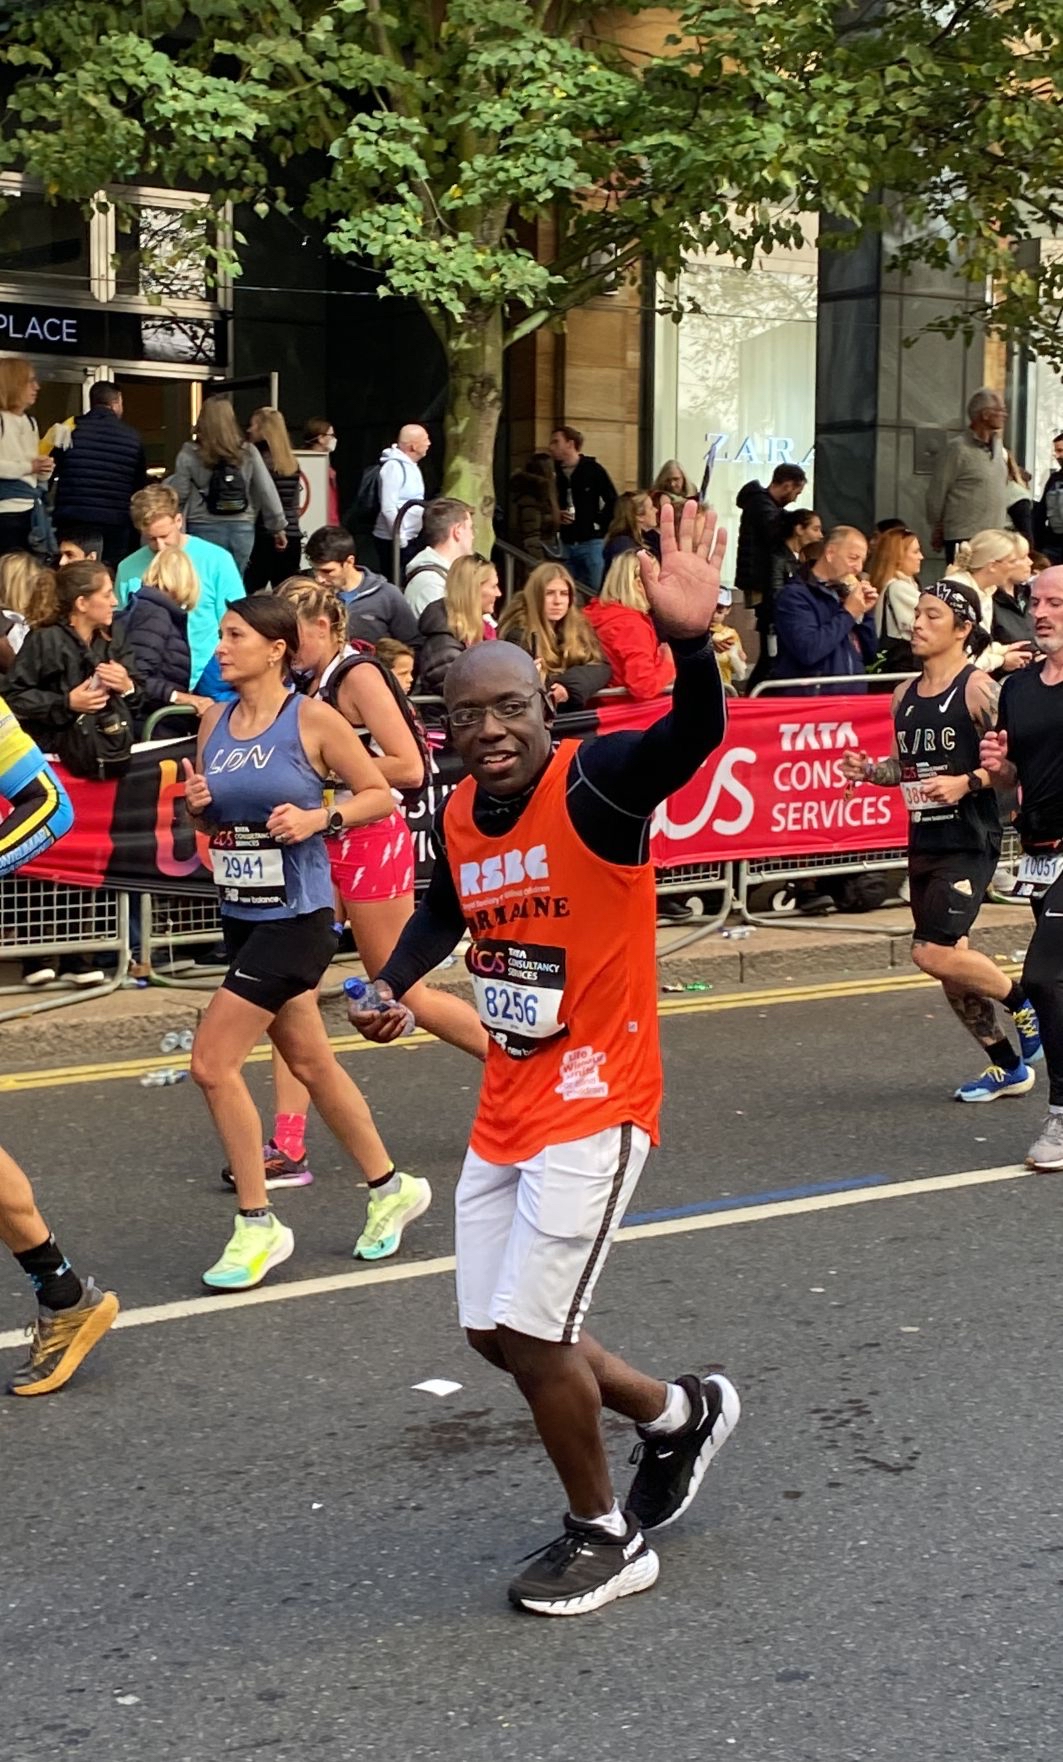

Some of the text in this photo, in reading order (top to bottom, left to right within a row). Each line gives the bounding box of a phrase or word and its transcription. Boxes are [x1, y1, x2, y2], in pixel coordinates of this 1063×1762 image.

[0, 313, 78, 342] PLACE
[779, 721, 860, 751] TATA
[208, 744, 276, 775] LDN
[770, 795, 892, 833] SERVICES
[223, 856, 263, 879] 2941
[460, 844, 549, 897] RSBC
[1024, 856, 1057, 877] 10051
[485, 986, 538, 1026] 8256
